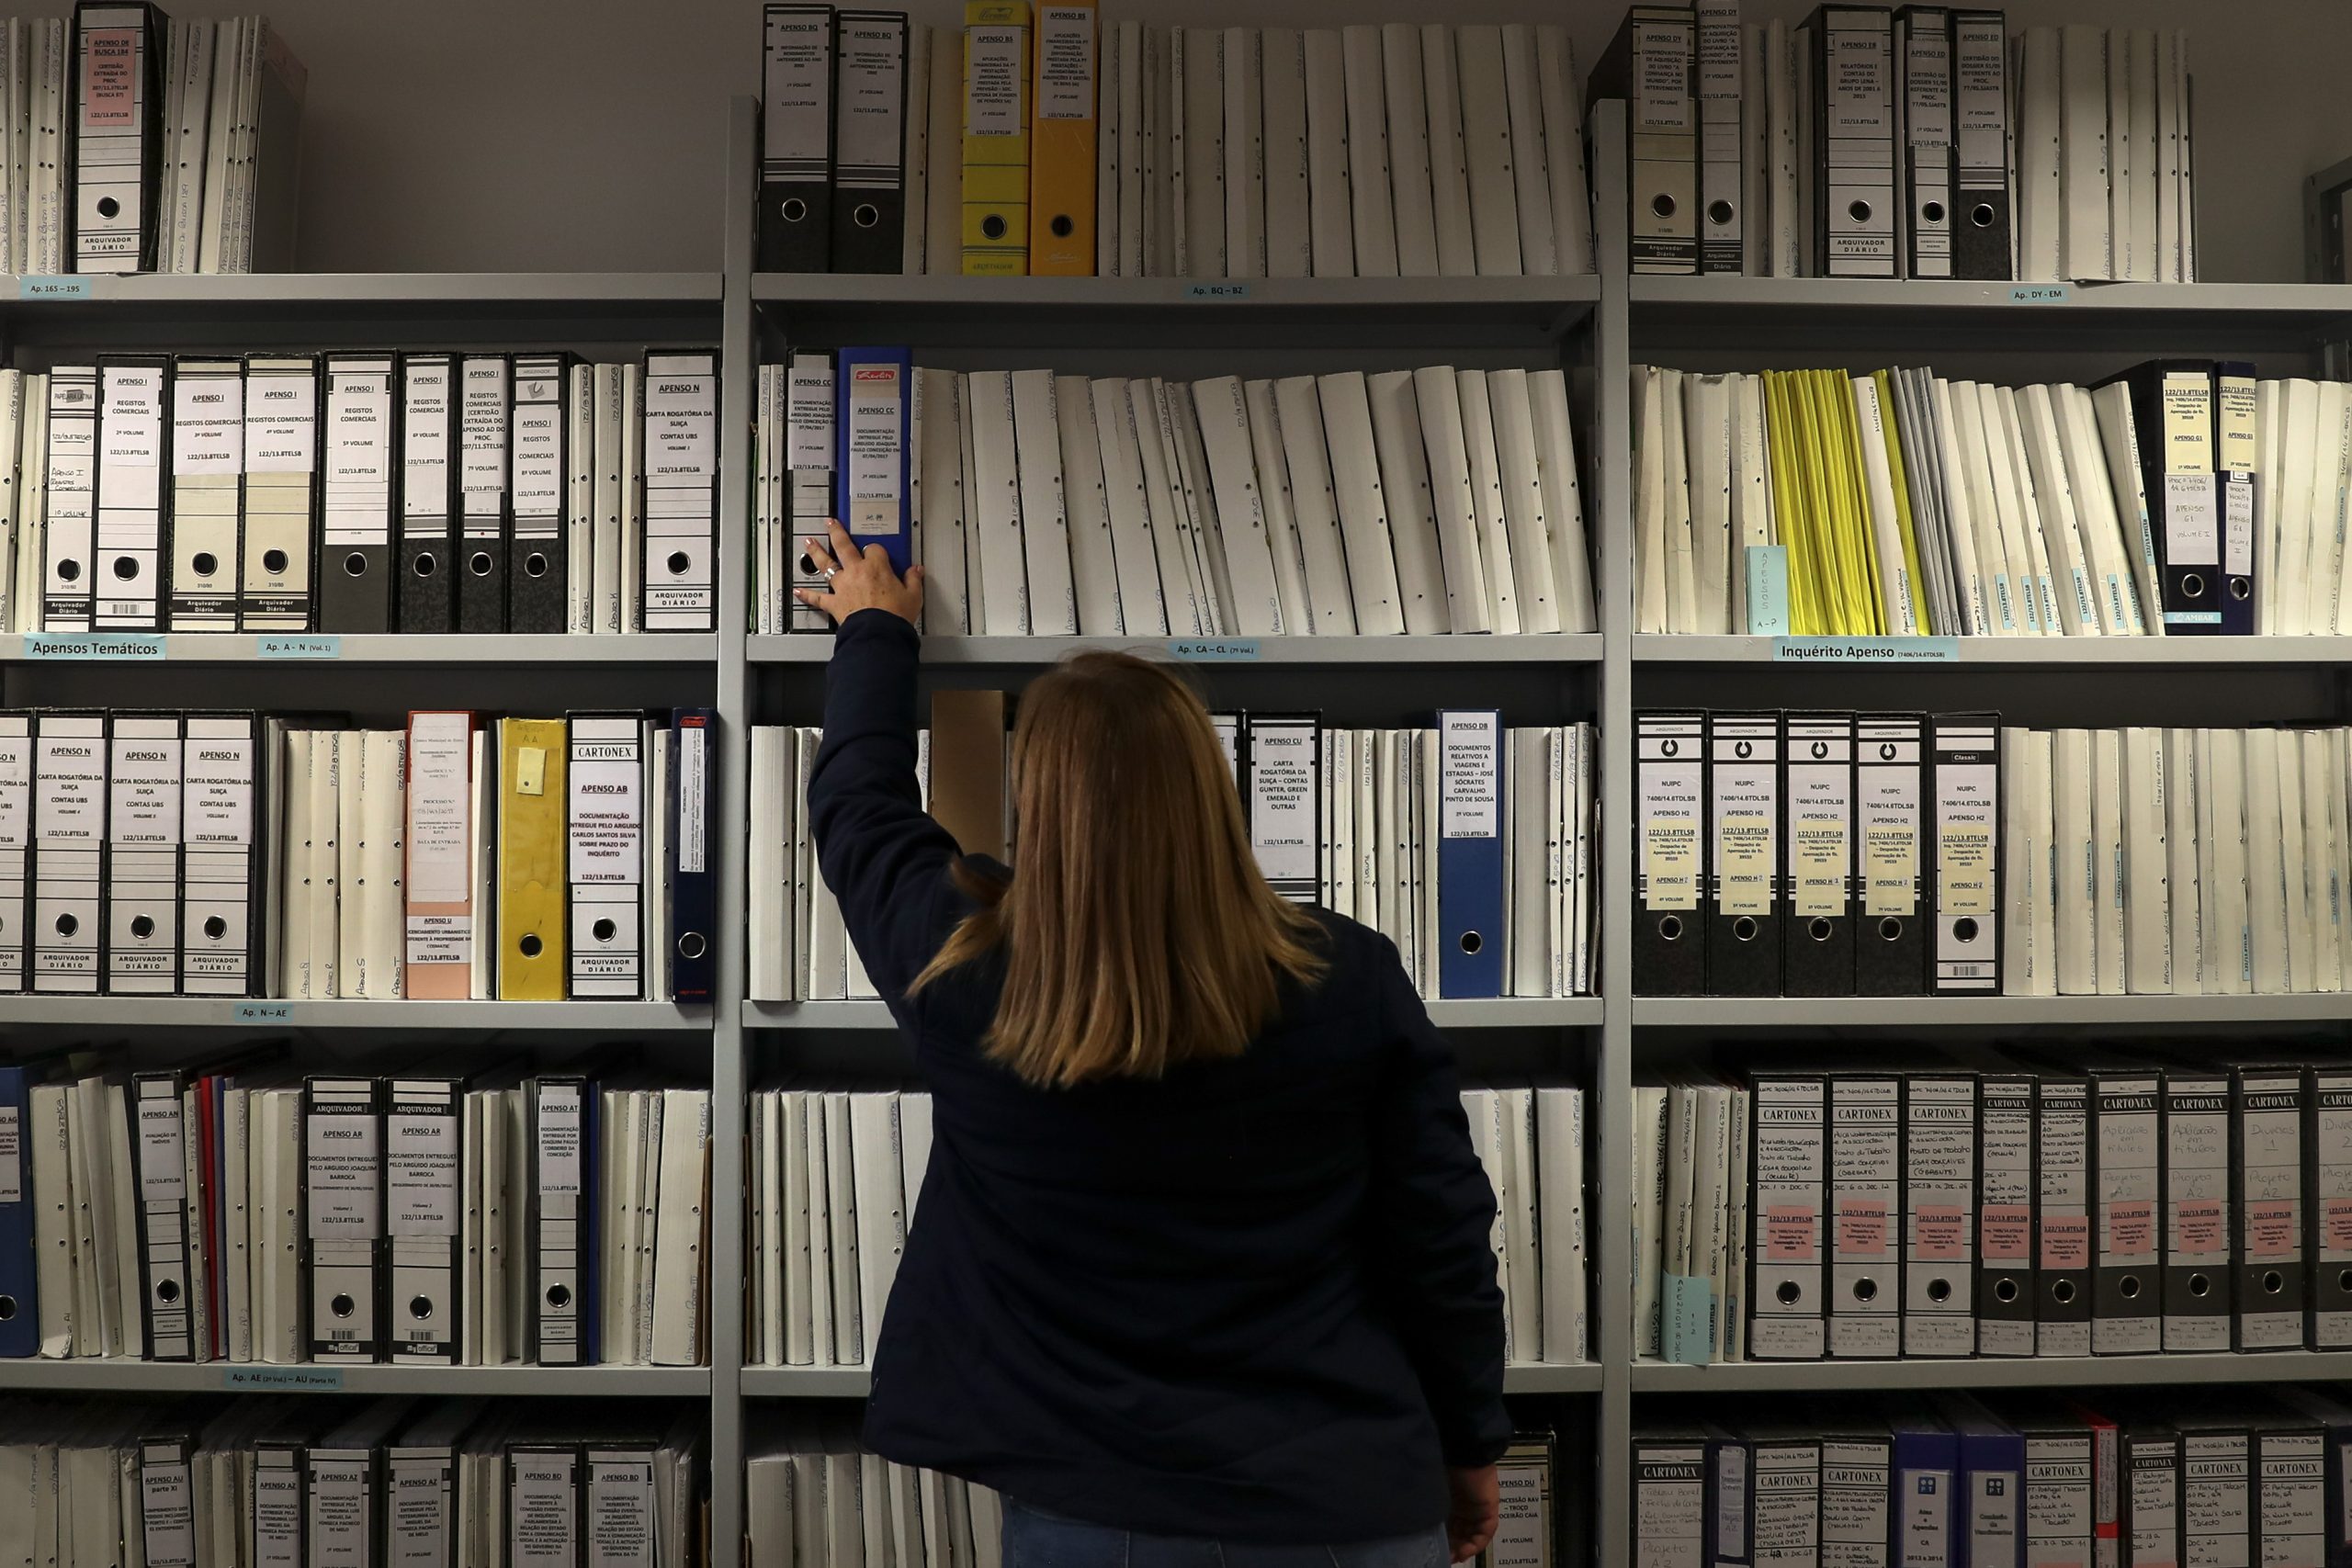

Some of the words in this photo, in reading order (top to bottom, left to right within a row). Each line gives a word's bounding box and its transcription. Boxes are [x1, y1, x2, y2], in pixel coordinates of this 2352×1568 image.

[1193, 287, 1206, 295] Ap.
[1211, 287, 1224, 295] BQ
[32, 641, 87, 656] Apensos
[91, 642, 157, 654] Temáticos
[266, 643, 279, 652] Ap.
[1177, 646, 1192, 654] Ap.
[1782, 645, 1842, 660] Inquérito
[1846, 646, 1894, 660] Apenso
[579, 747, 631, 757] CARTONEX
[243, 1009, 256, 1018] Ap.
[2104, 1098, 2153, 1109] CARTONEX
[2173, 1098, 2223, 1110] CARTONEX
[2248, 1096, 2295, 1107] CARTONEX
[316, 1105, 363, 1113] ARQUIVADOR
[1838, 1109, 1891, 1119] CARTONEX
[1914, 1109, 1967, 1119] CARTONEX
[1763, 1110, 1816, 1120] CARTONEX
[1644, 1467, 1697, 1477] CARTONEX
[2191, 1464, 2243, 1474] CARTONEX
[2267, 1463, 2317, 1474] CARTONEX
